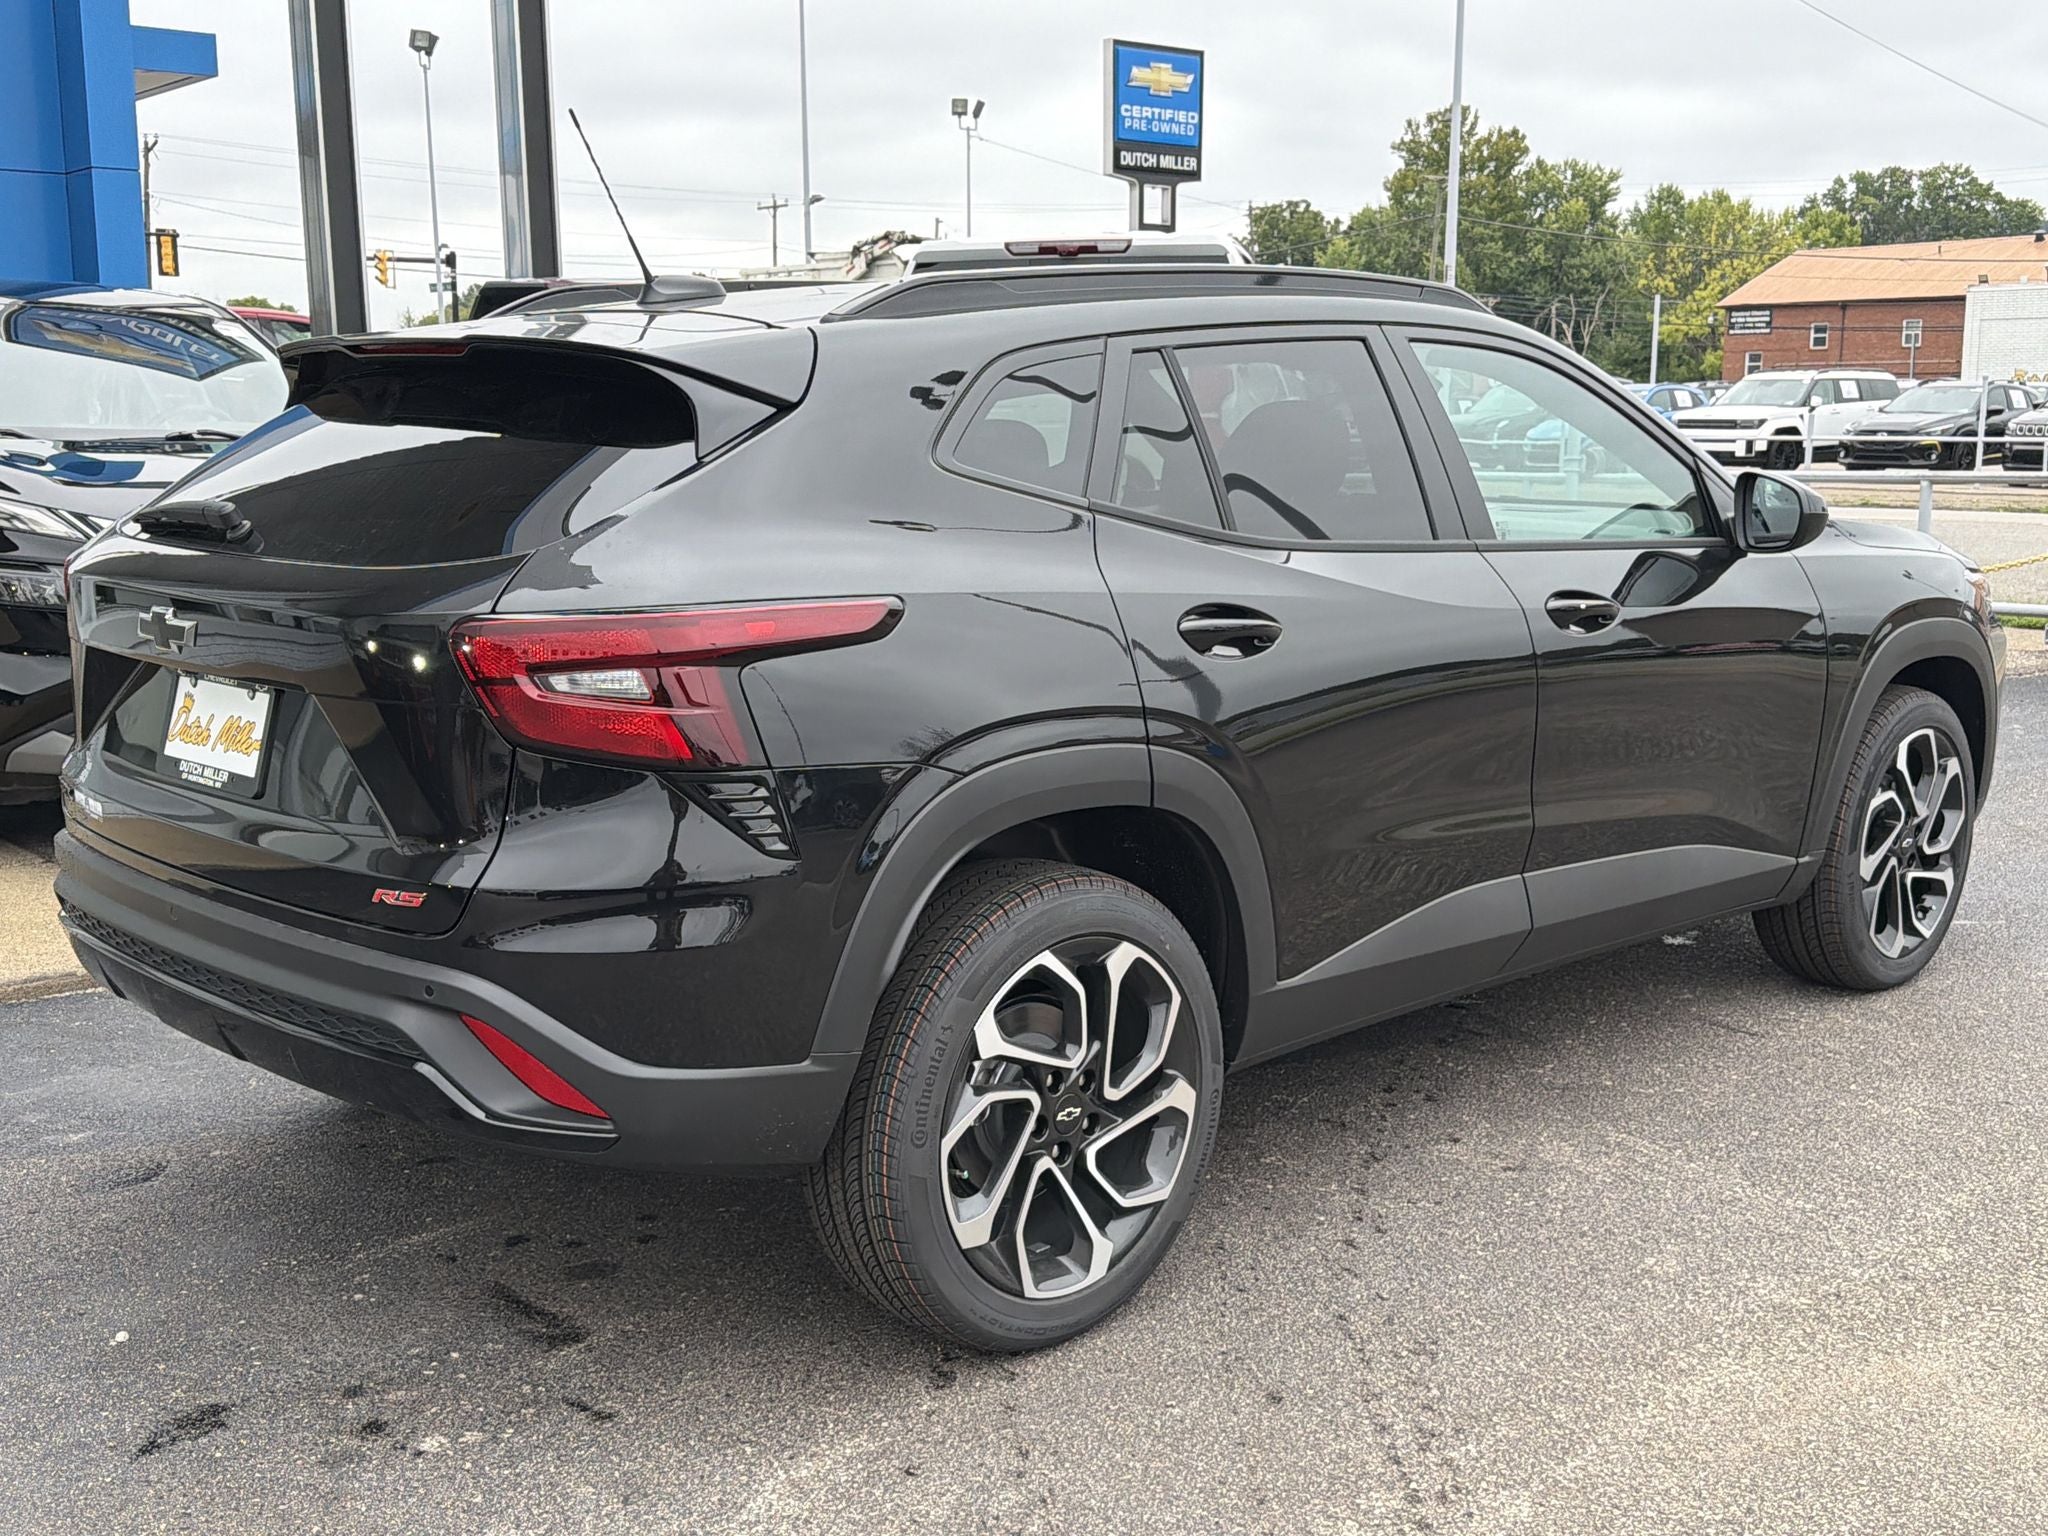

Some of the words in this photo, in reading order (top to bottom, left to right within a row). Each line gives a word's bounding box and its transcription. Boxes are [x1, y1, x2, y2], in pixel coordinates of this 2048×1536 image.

[1120, 104, 1199, 124] CERTIFIED
[1124, 118, 1195, 136] PRE-OWNED
[1120, 151, 1157, 168] DUTCH
[1159, 154, 1198, 172] MILLER
[167, 706, 214, 747] Dutch
[211, 715, 262, 757] Miller
[179, 760, 203, 776] DUTCH
[202, 766, 229, 783] MILLER
[372, 888, 427, 907] RS
[911, 1038, 949, 1149] Continental
